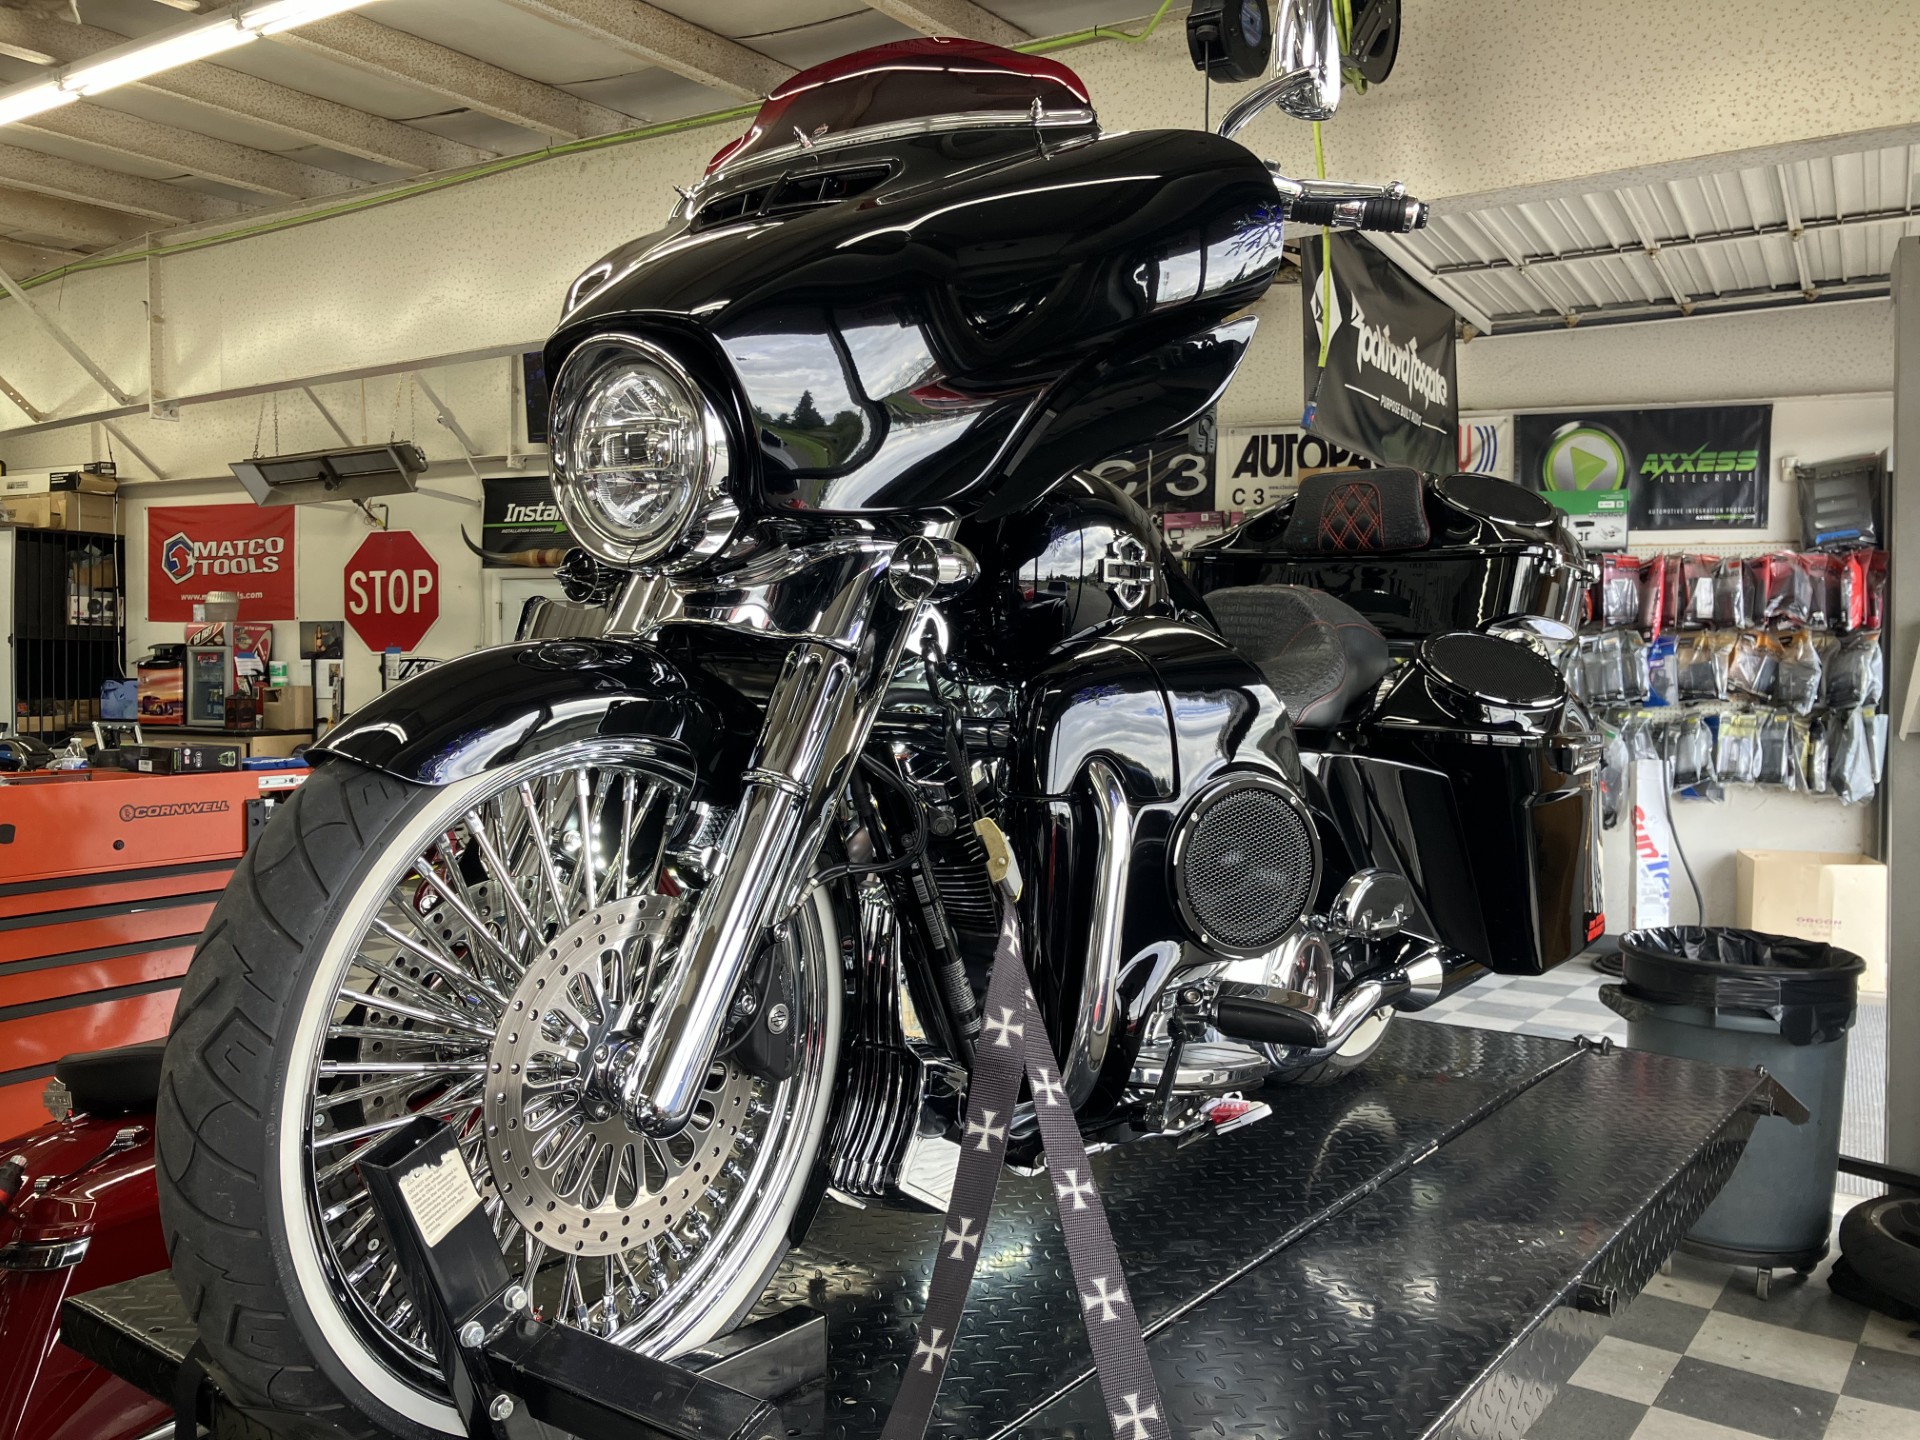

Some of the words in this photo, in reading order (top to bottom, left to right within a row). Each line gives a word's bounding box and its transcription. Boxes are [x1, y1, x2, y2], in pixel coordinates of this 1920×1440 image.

[1351, 290, 1410, 385] Rockford
[1380, 395, 1401, 415] PURPOSE
[1640, 447, 1759, 477] AXXESS
[1660, 473, 1753, 483] INTEGRATE
[193, 537, 285, 557] MATCO
[198, 556, 279, 575] TOOLS
[349, 569, 433, 615] STOP
[134, 801, 229, 818] CORNWELL
